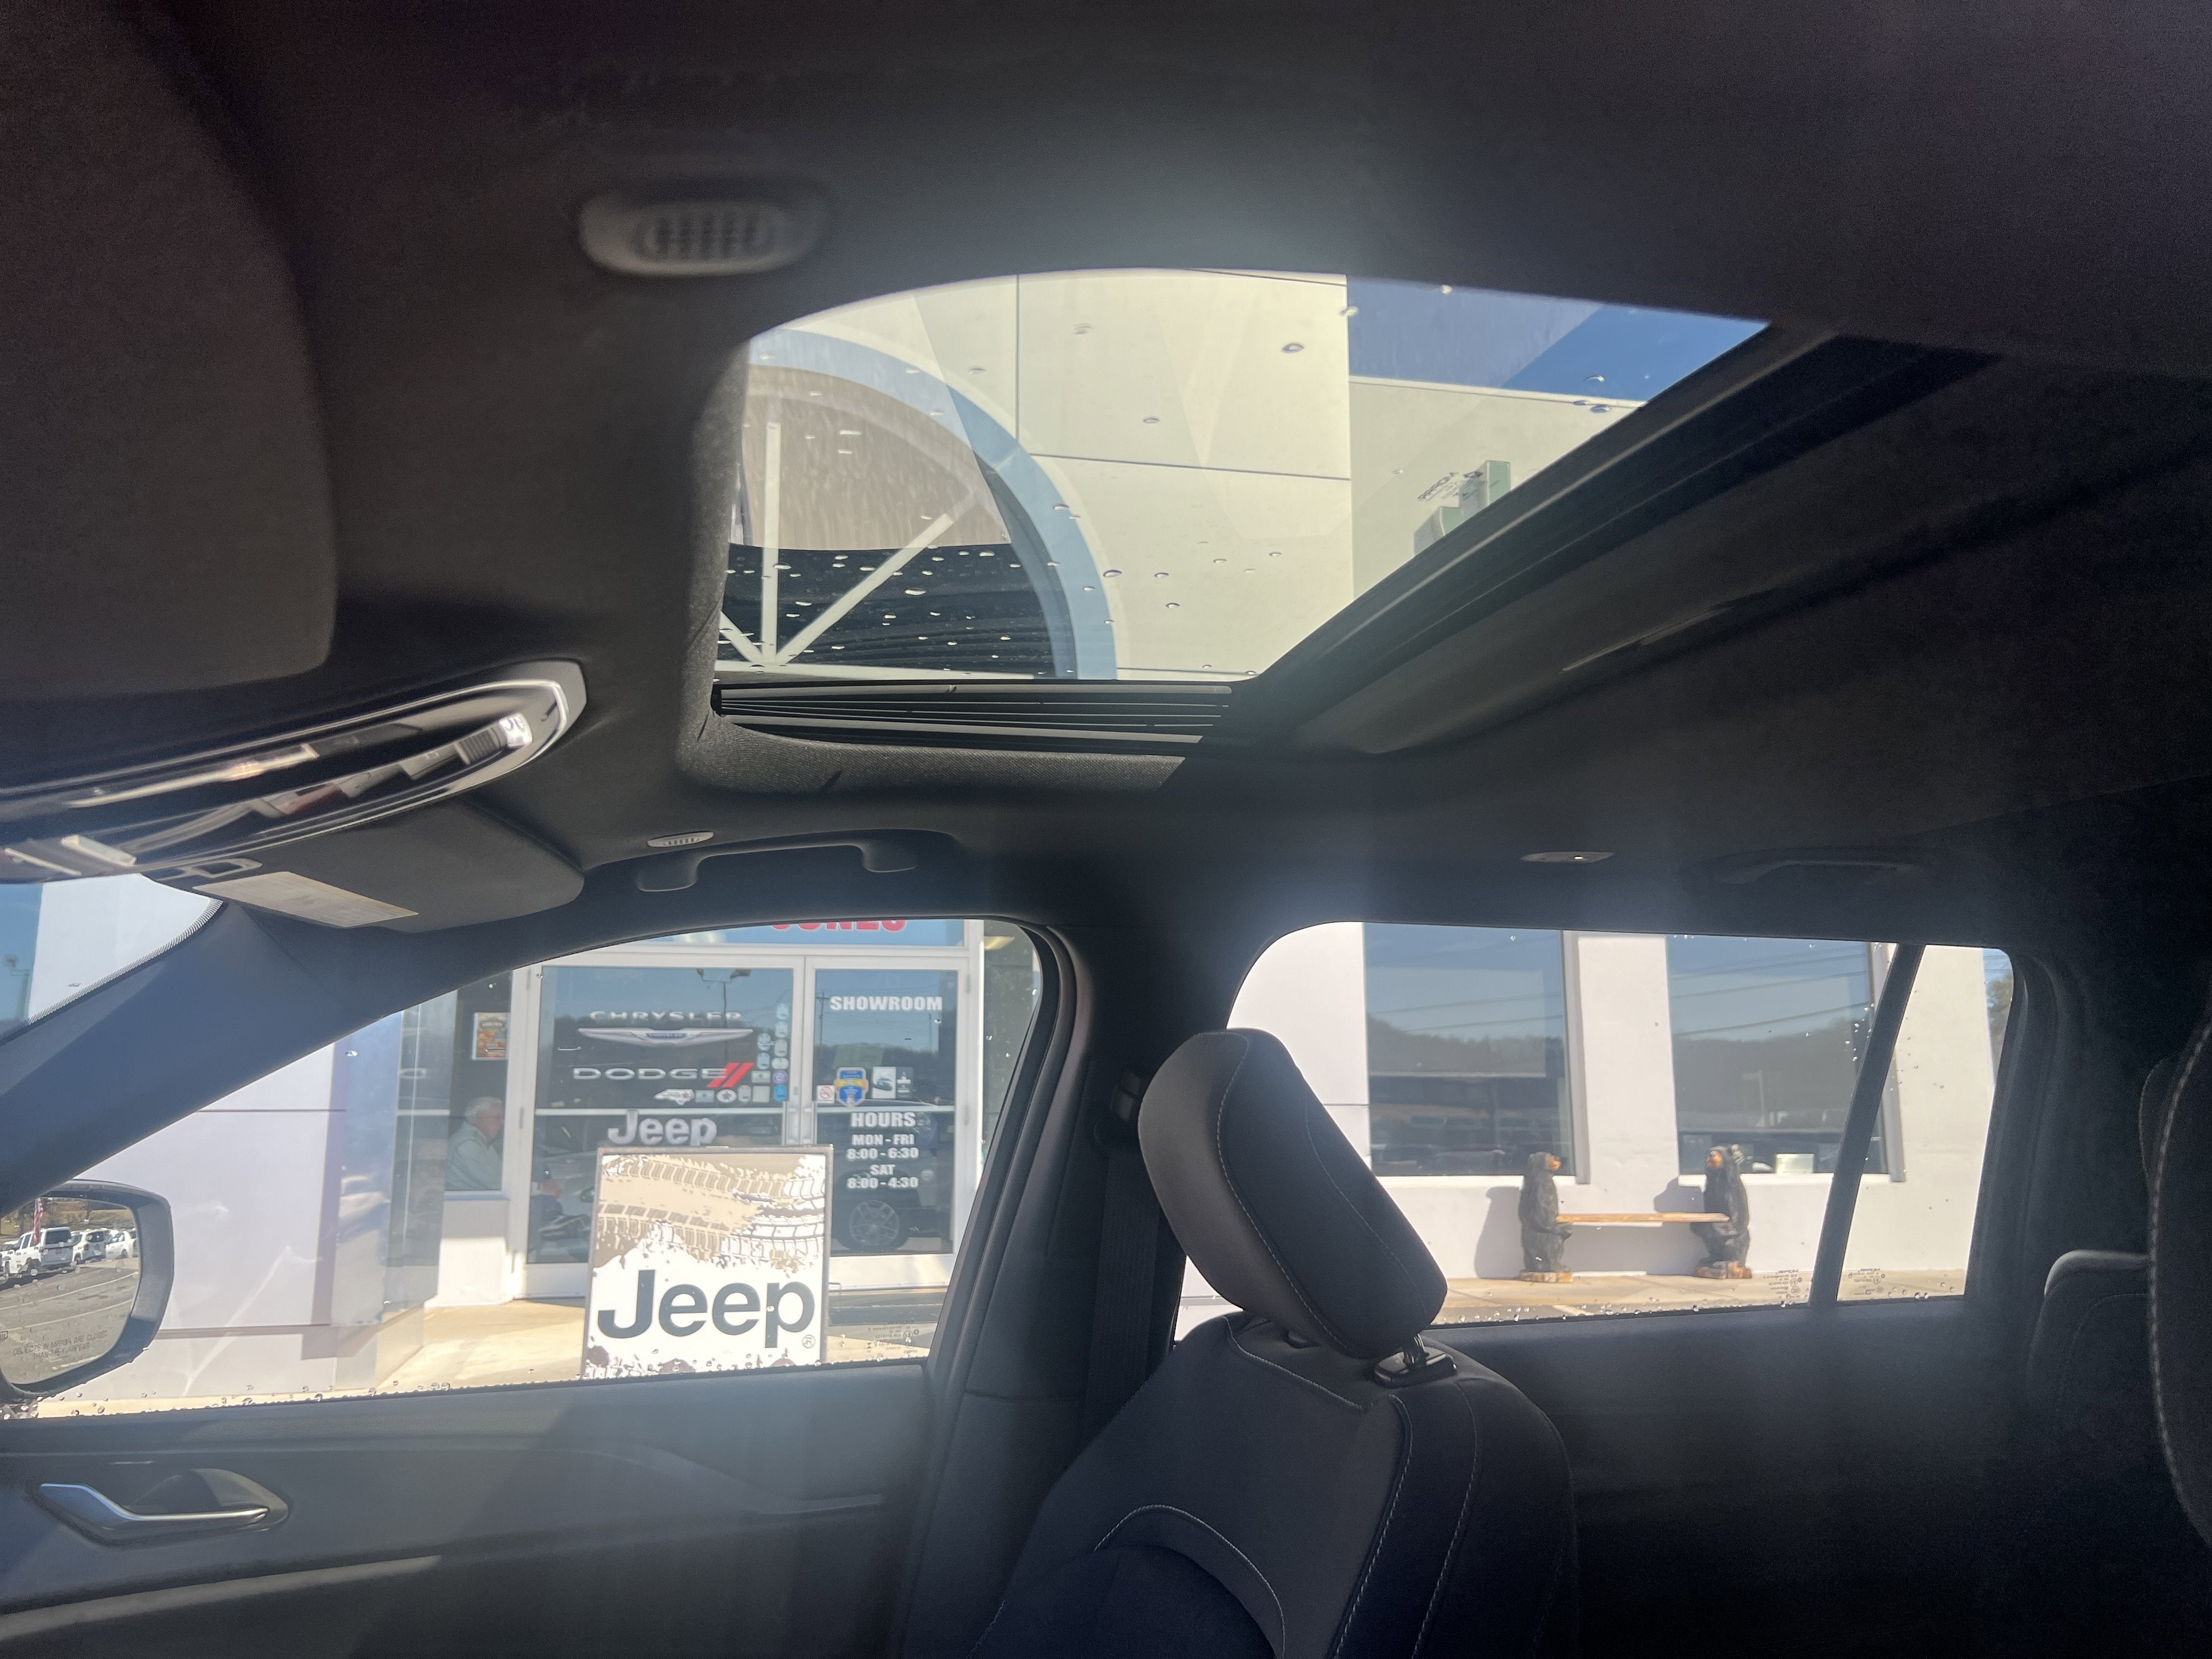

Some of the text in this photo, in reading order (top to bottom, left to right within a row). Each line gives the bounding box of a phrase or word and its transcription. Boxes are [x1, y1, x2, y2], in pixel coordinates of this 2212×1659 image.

[830, 996, 943, 1011] SHOWROOM
[590, 1011, 742, 1020] CHRYSLER
[573, 1068, 727, 1080] DODGE
[851, 1111, 916, 1127] HOURS
[607, 1109, 717, 1147] Jeep
[852, 1134, 883, 1146] MON
[893, 1133, 915, 1145] FRI
[869, 1164, 896, 1175] SAT
[888, 1177, 919, 1188] 4:30
[597, 1269, 815, 1348] Jeep
